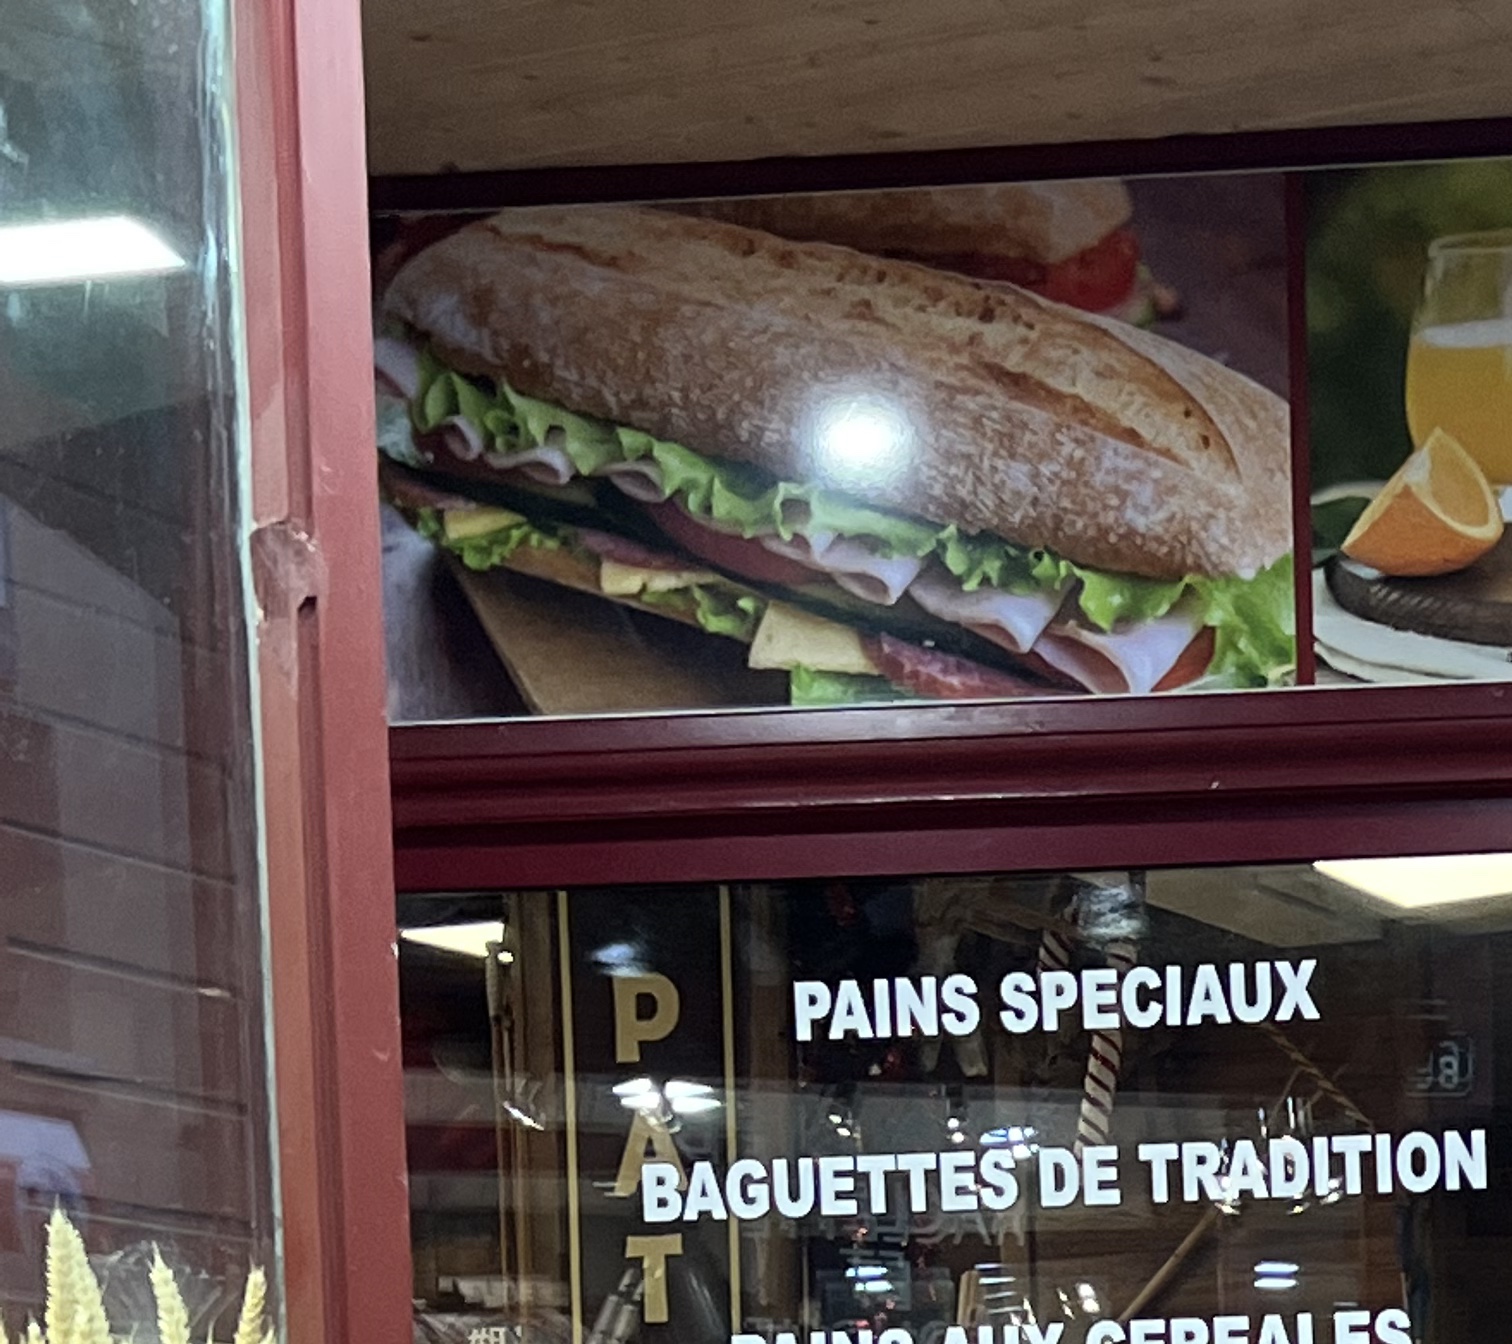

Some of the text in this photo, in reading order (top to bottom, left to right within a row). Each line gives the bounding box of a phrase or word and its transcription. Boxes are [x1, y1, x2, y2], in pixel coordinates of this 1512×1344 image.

[794, 960, 1320, 1040] PAINS SPECIAUX
[642, 1130, 1487, 1221] BAGUETTES DE TRADITION
